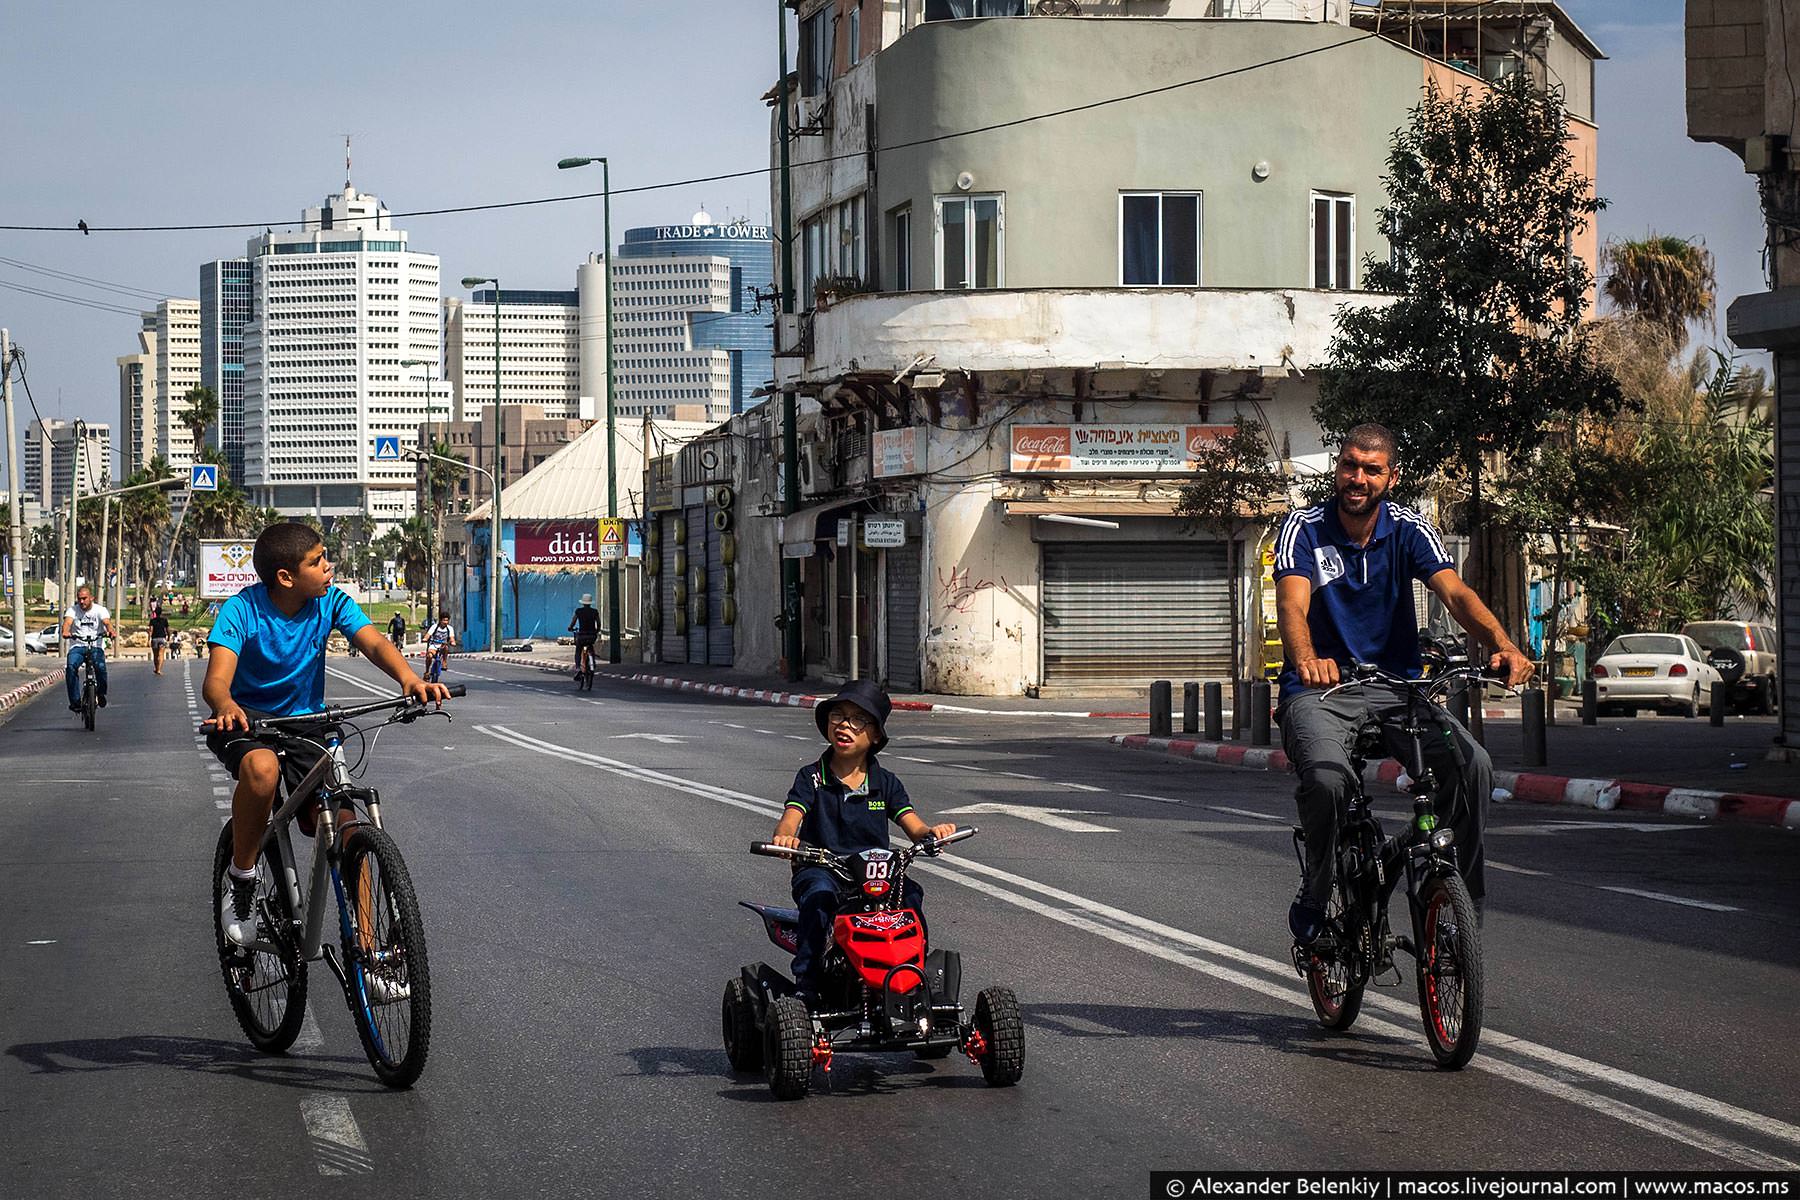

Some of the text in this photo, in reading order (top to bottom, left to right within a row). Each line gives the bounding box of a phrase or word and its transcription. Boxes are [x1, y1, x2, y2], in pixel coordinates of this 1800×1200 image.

[655, 225, 768, 239] TRADE TOWER
[548, 532, 595, 555] didi
[866, 861, 888, 879] 03
